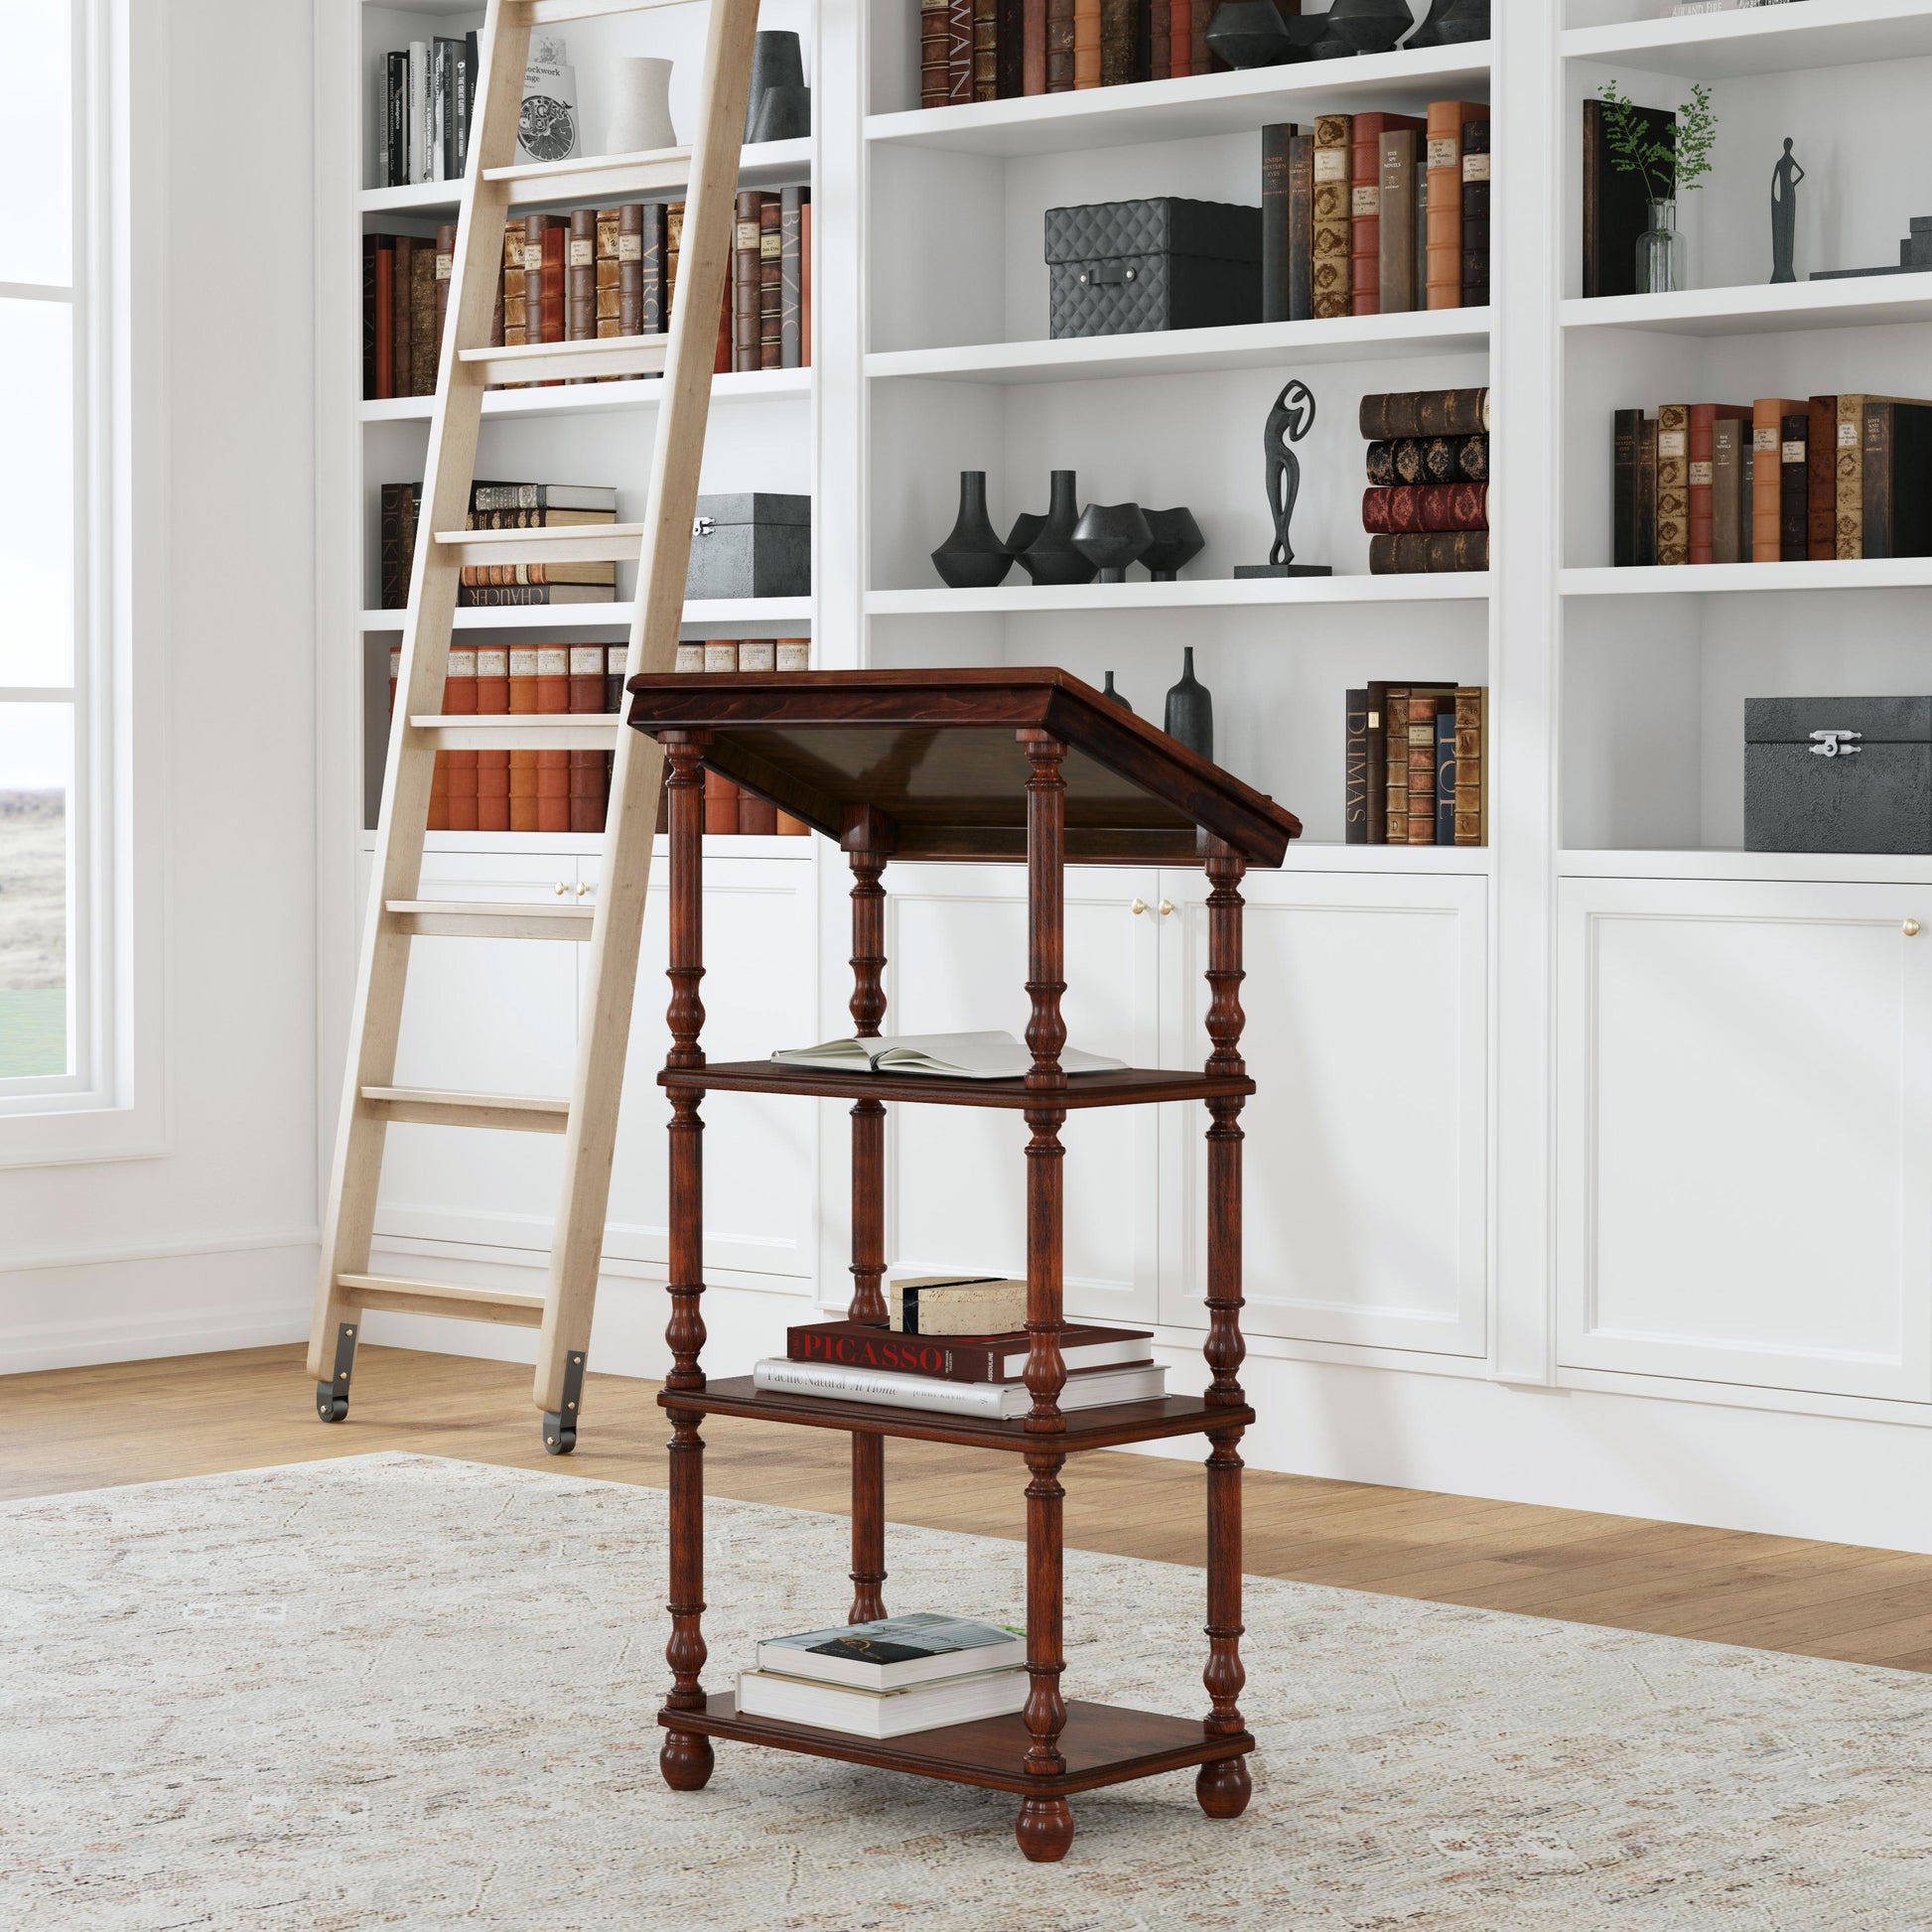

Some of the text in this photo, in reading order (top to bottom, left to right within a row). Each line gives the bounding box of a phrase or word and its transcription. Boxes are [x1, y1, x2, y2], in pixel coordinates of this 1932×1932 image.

[526, 67, 561, 76] ockwork
[643, 244, 659, 329] VIRGI
[781, 210, 800, 343] BALZAC
[383, 490, 399, 608] DICKENS
[470, 589, 544, 606] CHAUCER
[1347, 712, 1367, 823] DUMAS
[767, 1367, 803, 1385] Pacific
[805, 1371, 846, 1390] Natural
[804, 1333, 942, 1372] PICASSO
